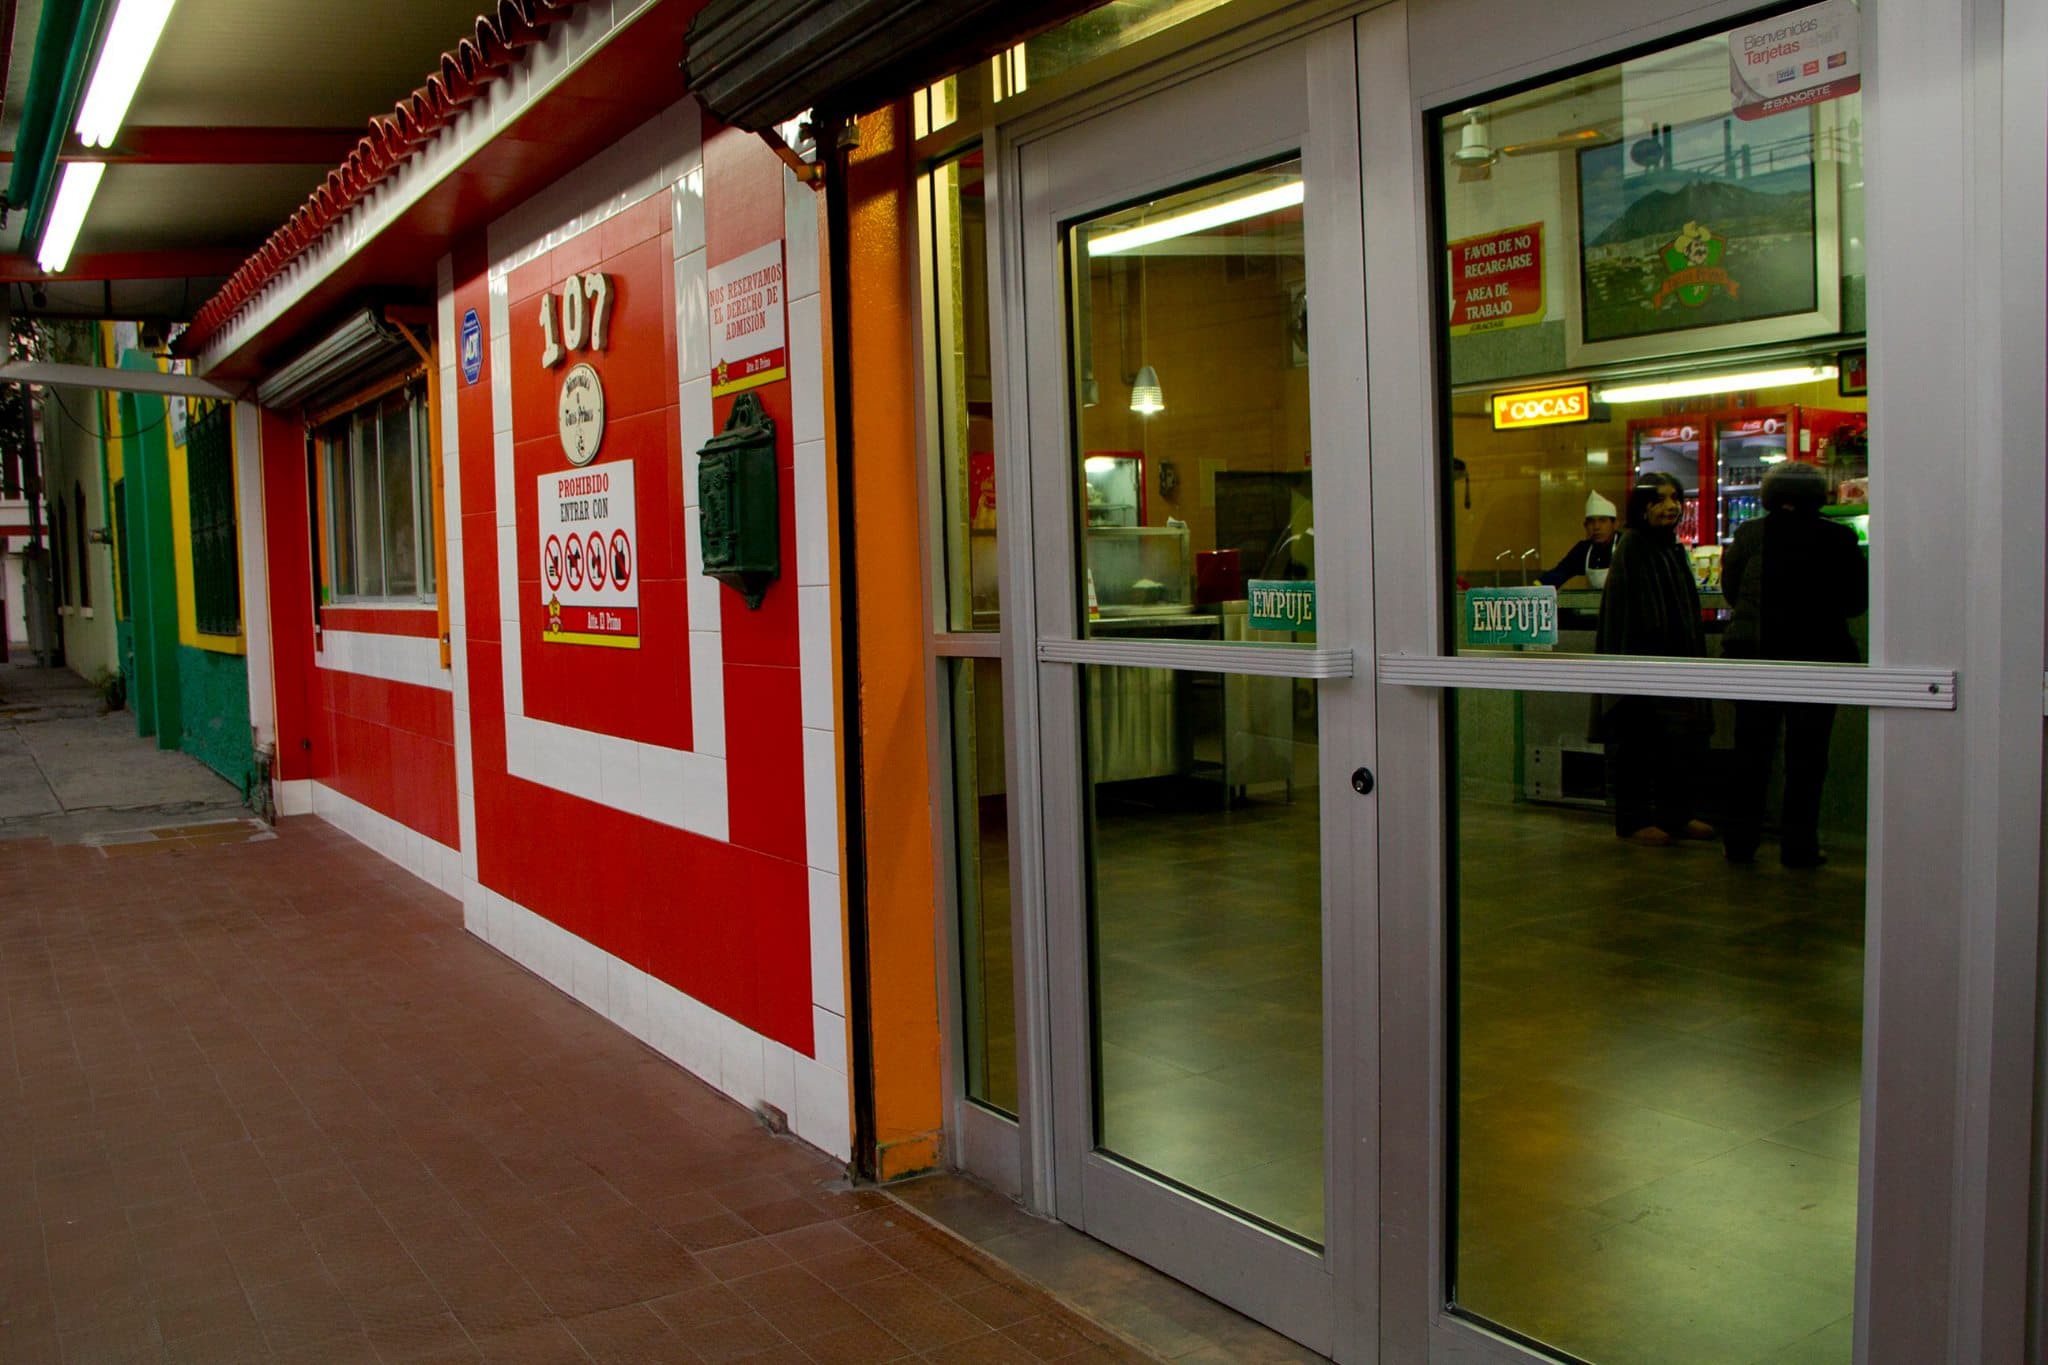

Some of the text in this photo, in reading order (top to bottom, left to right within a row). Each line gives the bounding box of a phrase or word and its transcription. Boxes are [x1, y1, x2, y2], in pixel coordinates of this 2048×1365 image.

[1744, 19, 1818, 51] Bienvenidas
[1745, 41, 1800, 66] Tarjetas
[1774, 85, 1831, 108] BANORTE
[1464, 234, 1531, 261] FAVOR DE NO
[1465, 252, 1533, 279] RECARGARSE
[709, 264, 782, 307] NOS RESERVAMOS
[1466, 281, 1509, 303] AREA DE
[714, 285, 778, 325] EL DERECHO DE
[1466, 300, 1513, 321] TRABAJO
[539, 272, 614, 369] 107
[1510, 396, 1581, 420] COCAS
[558, 472, 609, 498] PROHIBIDO
[560, 497, 609, 523] ENTRAR CON
[1252, 590, 1313, 625] EMPUJE
[1472, 598, 1554, 638] EMPUJE
